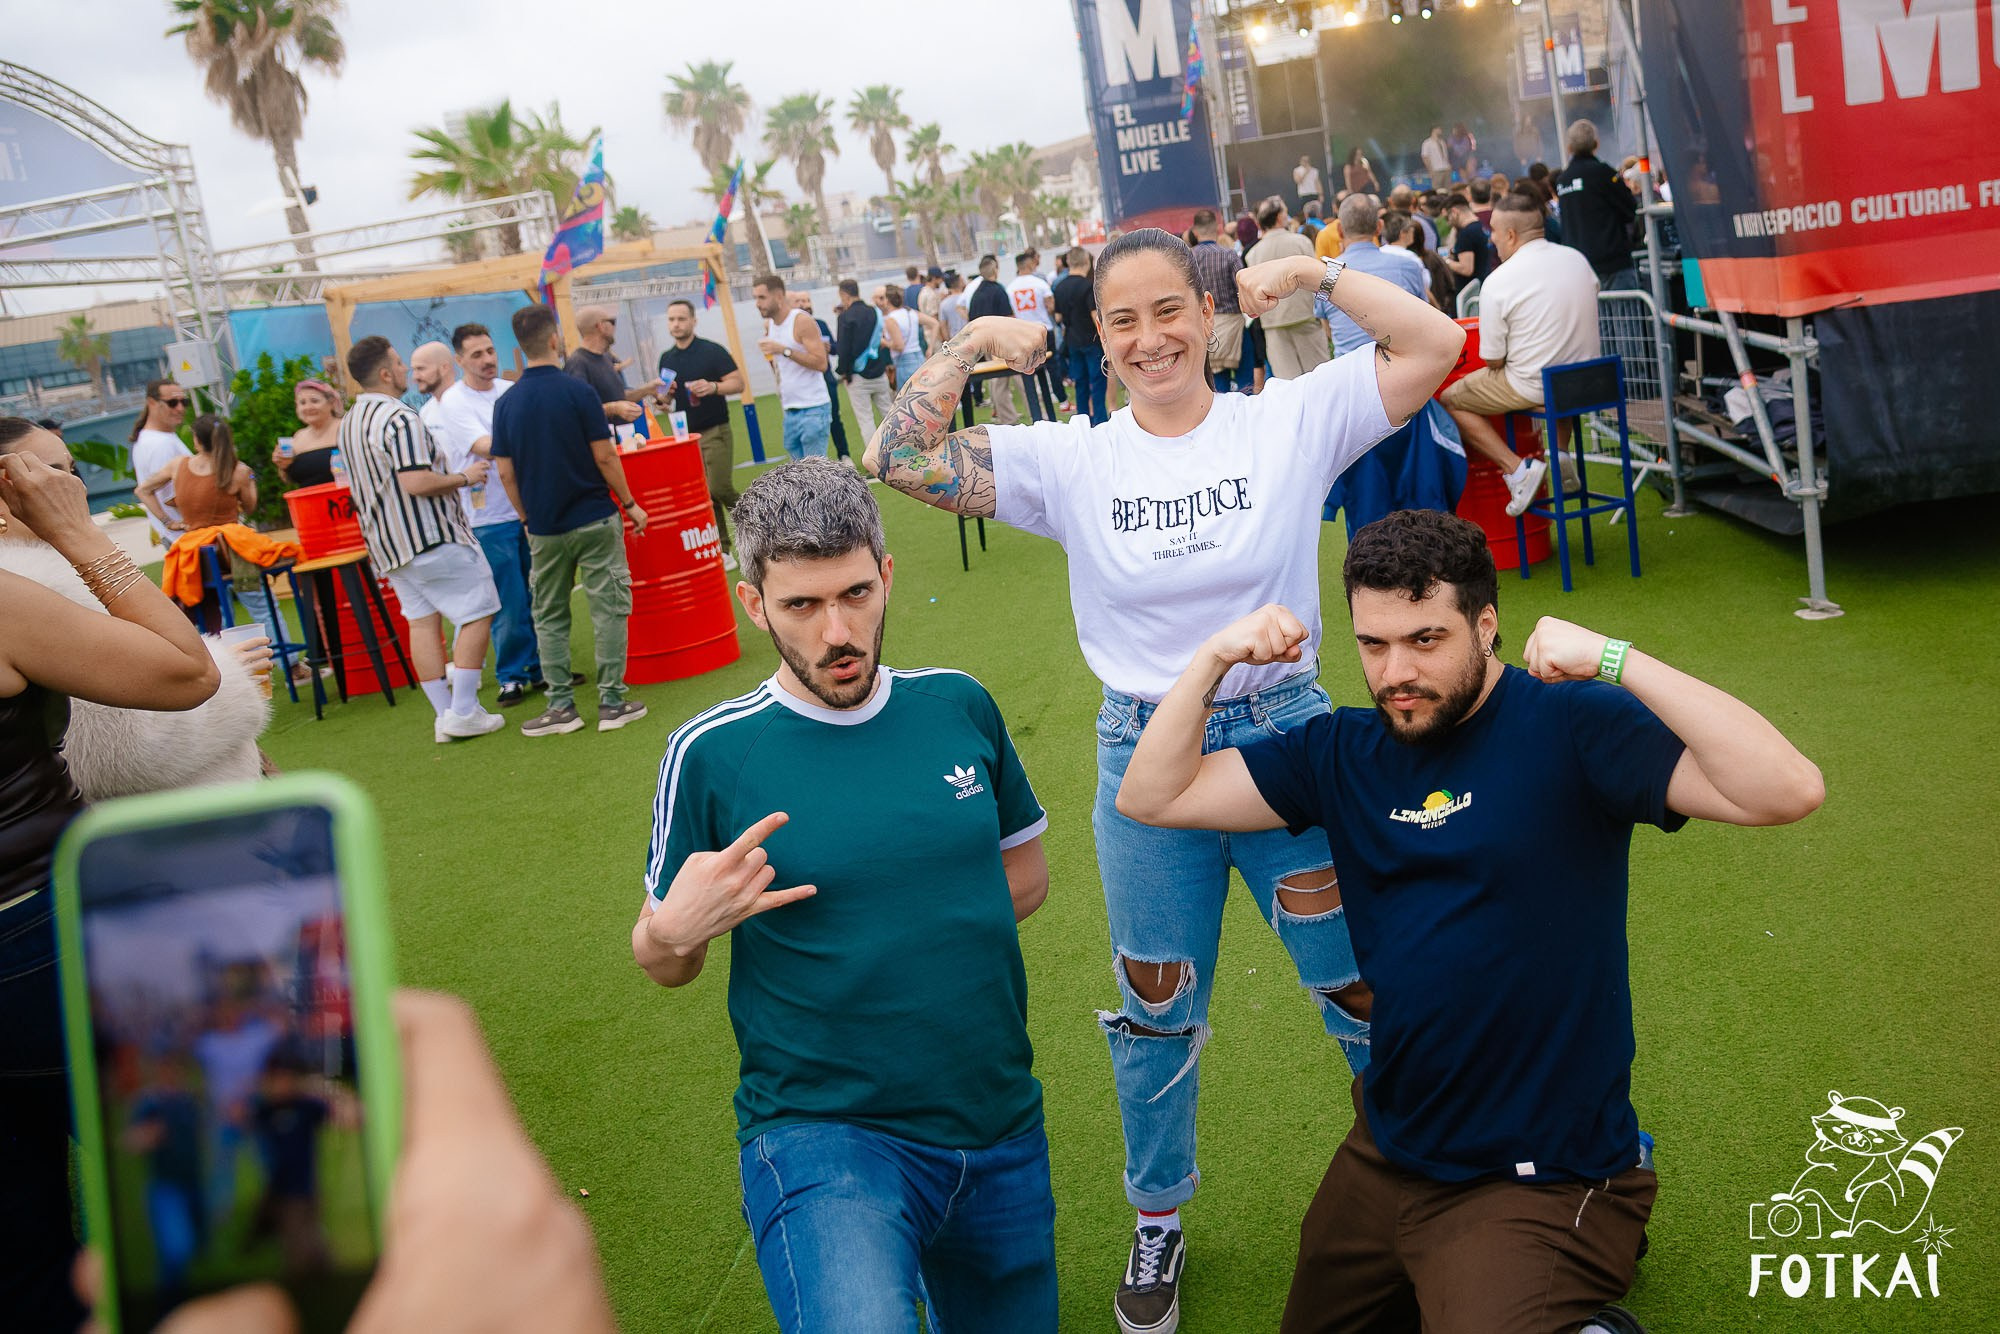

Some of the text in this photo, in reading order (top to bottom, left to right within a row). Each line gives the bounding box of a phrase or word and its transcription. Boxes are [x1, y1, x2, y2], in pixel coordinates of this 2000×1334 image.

[1095, 0, 1182, 87] M
[1837, 0, 2000, 106] M
[1112, 103, 1137, 127] EL
[1116, 119, 1192, 151] MUELLE
[1120, 149, 1162, 176] LIVE
[1763, 201, 1842, 236] ESPACIO
[1851, 184, 1972, 224] CULTURAL
[1112, 477, 1252, 533] BEETLEJUICE
[1152, 540, 1222, 561] THREE TIMES...
[1169, 532, 1198, 546] SAY IT
[955, 783, 984, 800] adidas
[1389, 791, 1472, 824] LIMONCELLO
